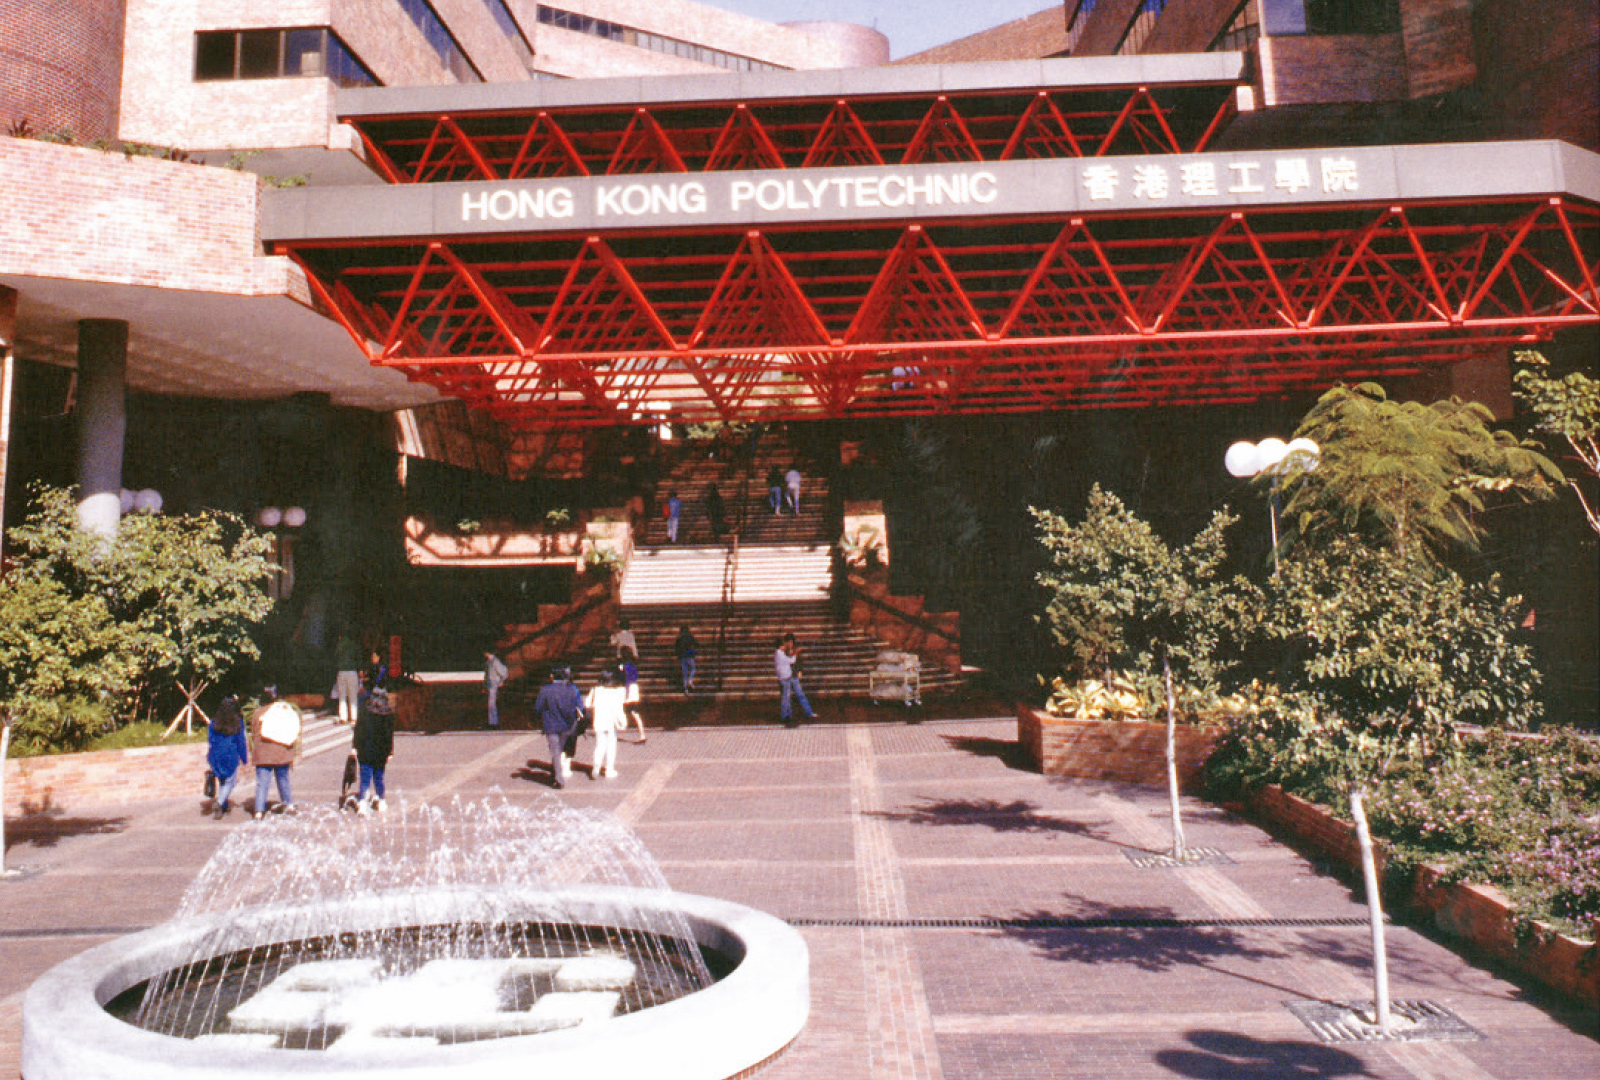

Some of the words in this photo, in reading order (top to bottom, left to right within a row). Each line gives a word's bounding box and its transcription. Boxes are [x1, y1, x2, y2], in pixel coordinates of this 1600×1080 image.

[461, 187, 574, 221] HONG
[596, 183, 708, 216] KONG
[730, 171, 999, 212] POLYTECHNIC
[1082, 157, 1359, 200] 香港理工學院
